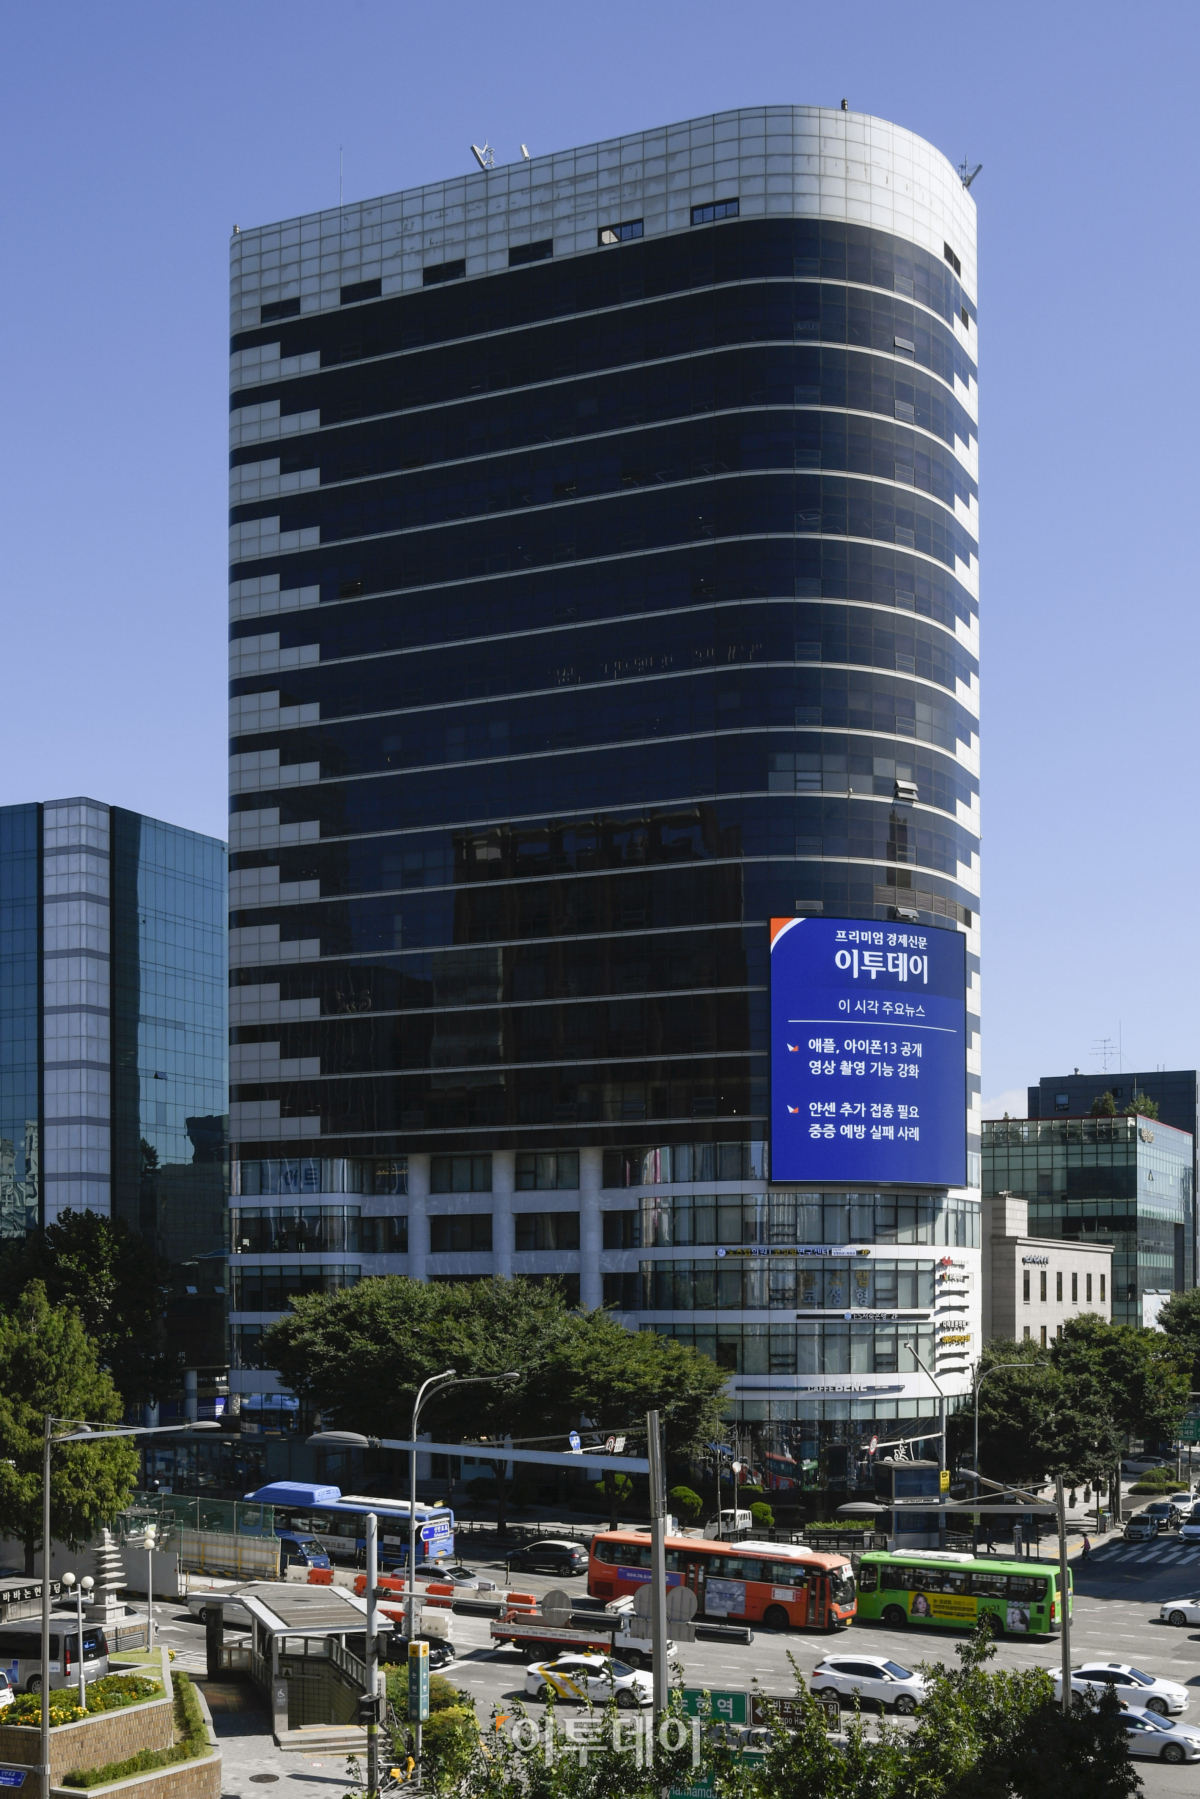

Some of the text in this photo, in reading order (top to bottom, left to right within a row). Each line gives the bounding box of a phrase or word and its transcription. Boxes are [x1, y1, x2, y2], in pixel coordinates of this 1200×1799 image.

[834, 930, 928, 950] 프리미엄 경제신문
[834, 949, 928, 984] 이투데이
[838, 999, 926, 1017] 이 시각 주요뉴스
[808, 1038, 922, 1057] 애플, 아이폰13 공개
[808, 1061, 919, 1078] 영상 촬영 기능 강화
[808, 1102, 919, 1119] 얀센 추가 접종 필요
[808, 1124, 919, 1141] 중증 예방 실패 사례
[835, 1381, 868, 1392] BENE
[2, 1582, 61, 1603] 바바논현딩
